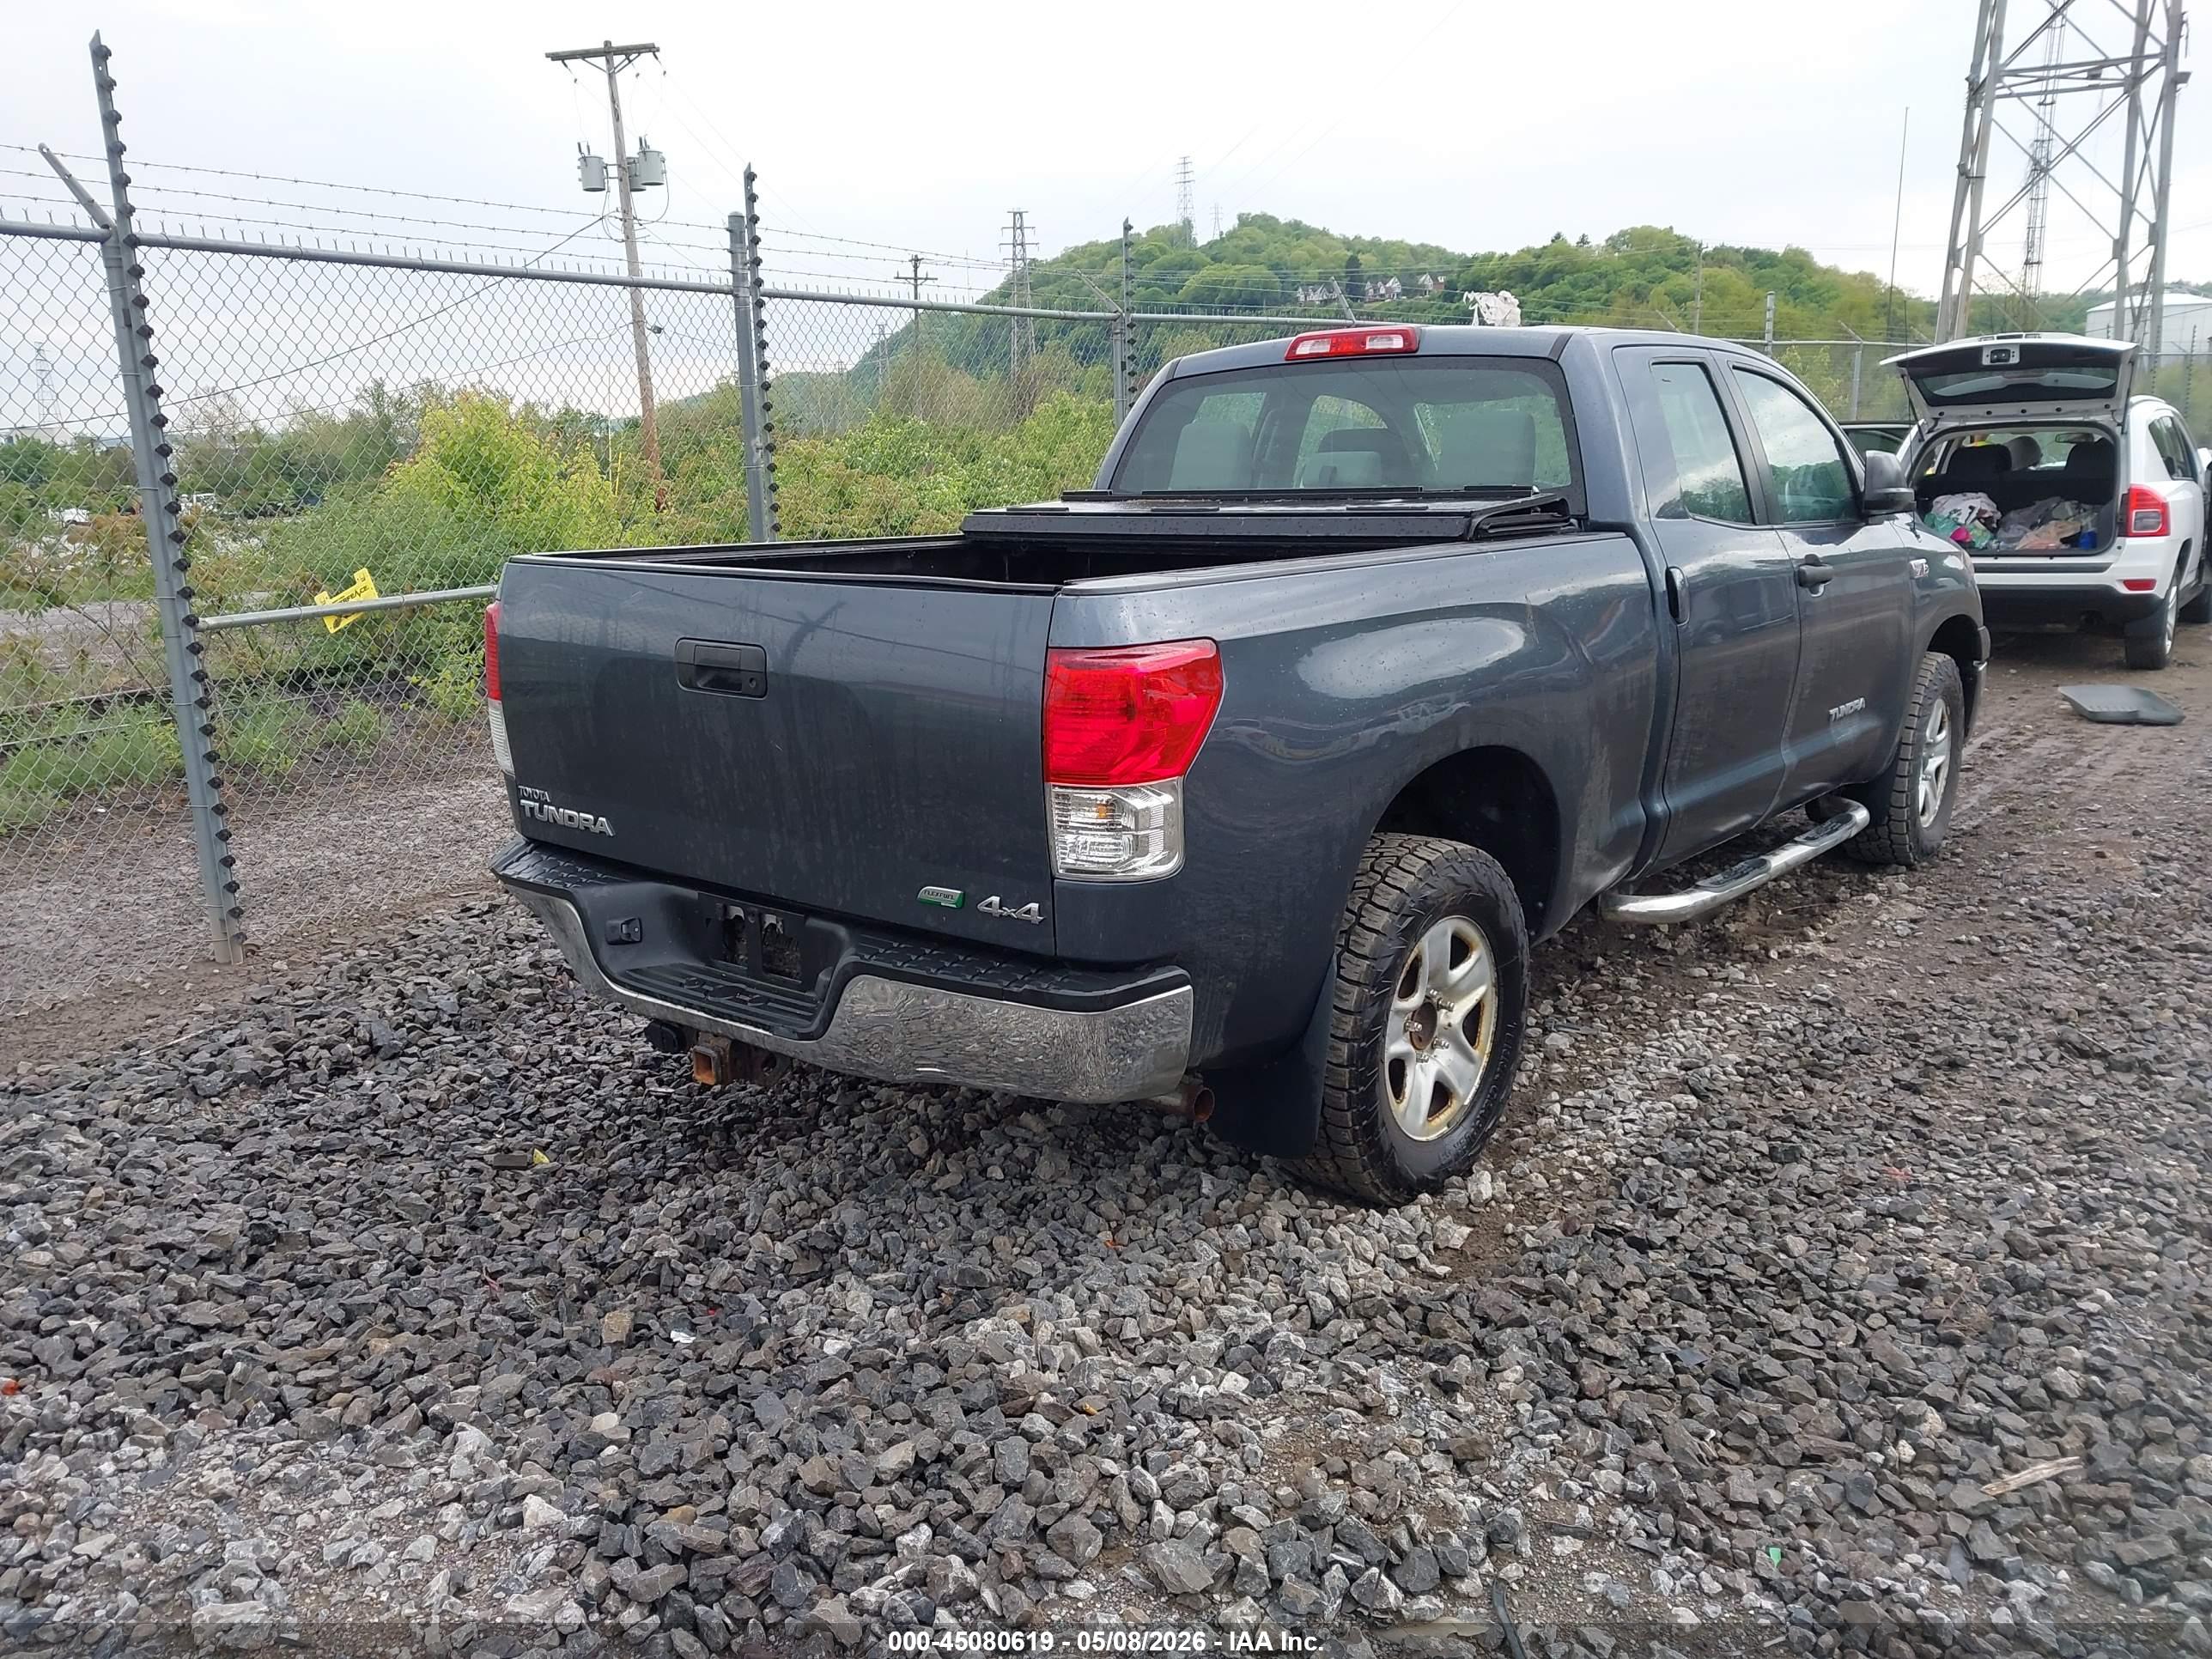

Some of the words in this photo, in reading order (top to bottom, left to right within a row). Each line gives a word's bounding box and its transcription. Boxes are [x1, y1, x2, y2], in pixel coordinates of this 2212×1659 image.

[1828, 697, 1866, 721] TUNDRA
[518, 785, 551, 803] TOYOTA
[520, 799, 616, 837] TUNDRA
[977, 895, 1046, 925] 4x4
